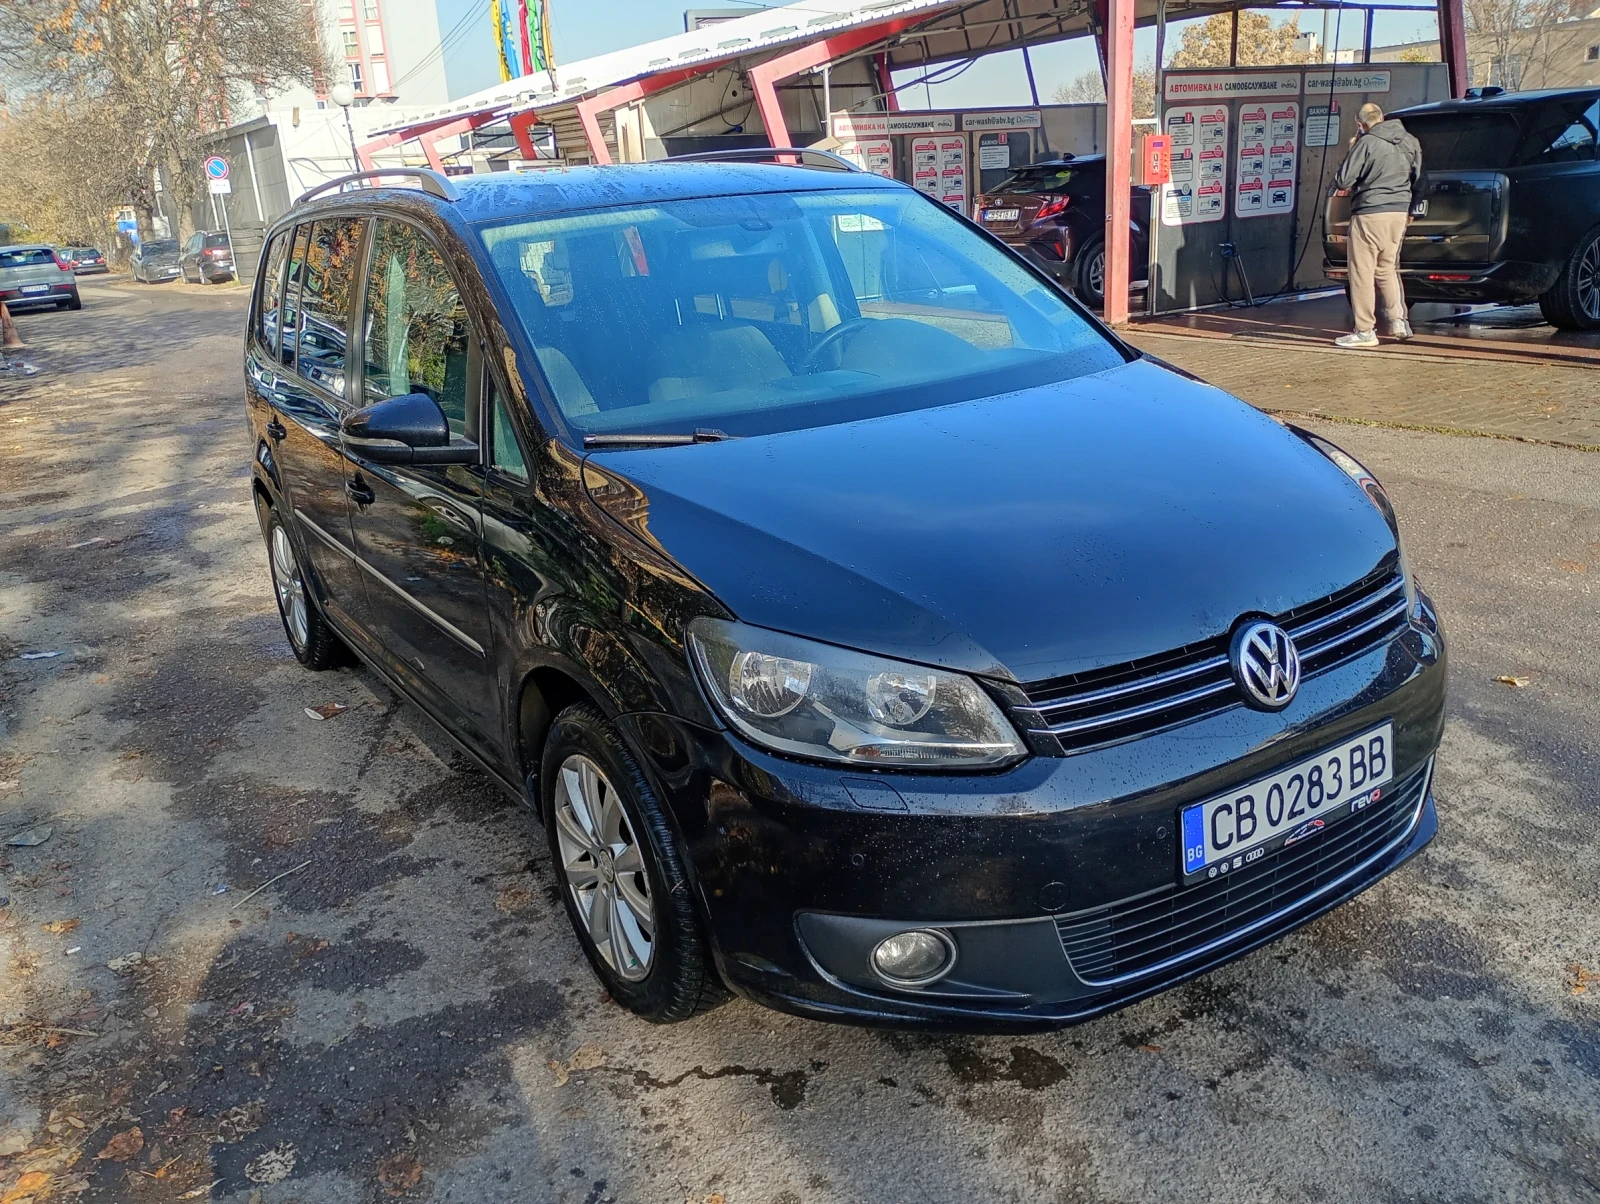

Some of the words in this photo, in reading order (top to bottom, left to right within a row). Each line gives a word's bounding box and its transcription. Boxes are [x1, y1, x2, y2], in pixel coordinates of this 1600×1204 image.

[1170, 84, 1212, 93] АВТОМИВКА
[1213, 83, 1224, 92] НА
[1224, 81, 1278, 91] САМООБСЛУЖВАНЕ
[839, 123, 876, 132] АВТОМИВКА
[887, 121, 935, 130] САМООБСЛУЖВАНЕ
[965, 116, 1015, 126] car-wash@abv.bg
[1211, 794, 1257, 851] CB
[1266, 756, 1343, 827] 0283
[1349, 735, 1387, 791] BB
[1187, 845, 1203, 863] BG
